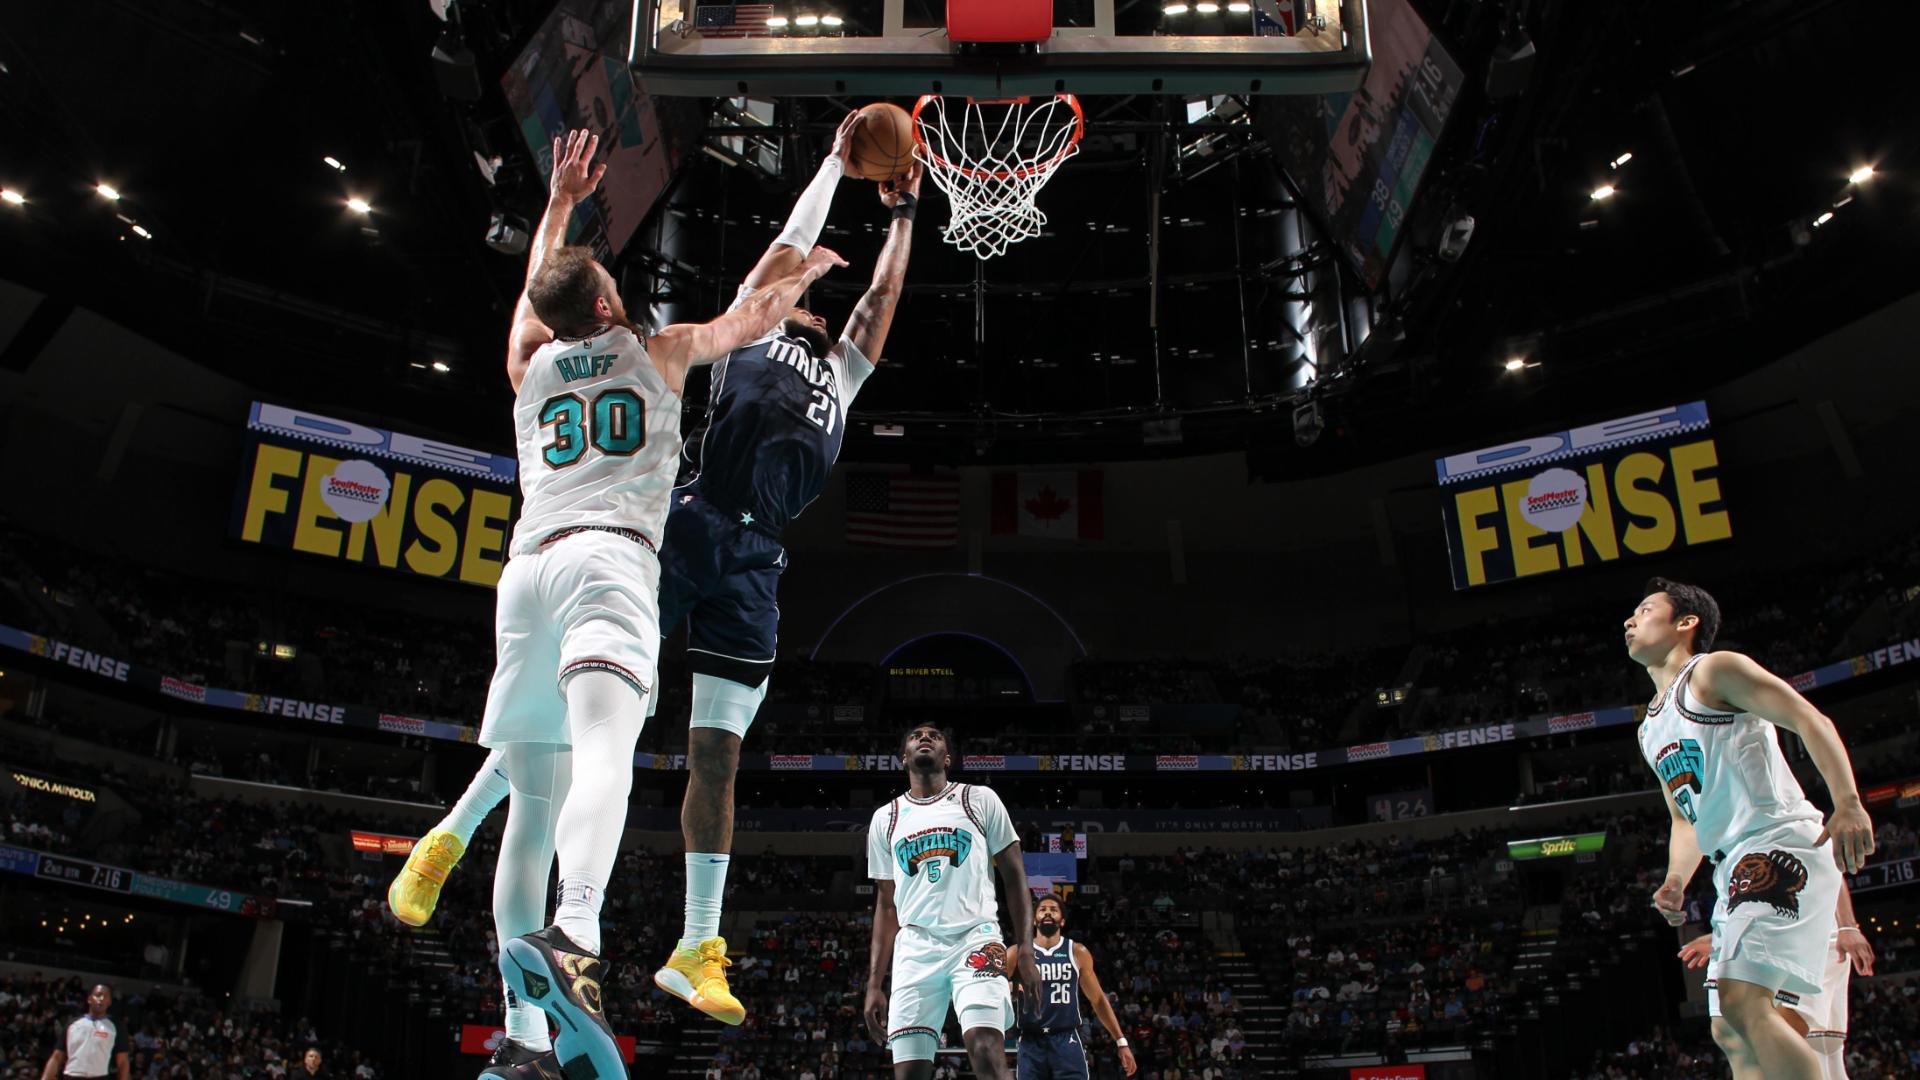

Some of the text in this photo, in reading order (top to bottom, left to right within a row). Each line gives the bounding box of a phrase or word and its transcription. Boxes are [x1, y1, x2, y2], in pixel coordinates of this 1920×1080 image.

[1413, 55, 1443, 107] 7:16
[1371, 178, 1390, 212] 38
[1385, 199, 1404, 230] 49
[556, 354, 618, 383] HUFF
[805, 389, 837, 436] 21
[257, 402, 494, 473] DE
[539, 388, 646, 470] 30
[1445, 405, 1681, 477] DE
[329, 477, 382, 495] SealMaster
[1528, 488, 1578, 505] SealMaster
[241, 443, 513, 588] FENSE
[1454, 438, 1733, 587] FENSE
[54, 641, 130, 682] FENSE
[890, 668, 904, 677] BIG
[906, 668, 929, 677] RIVER
[268, 696, 345, 724] FENSE
[1444, 724, 1515, 749] FENSE
[865, 754, 905, 771] FEN
[1058, 754, 1126, 771] FENSE
[1251, 752, 1318, 771] FENSE
[50, 782, 97, 803] MINOLTA
[1184, 820, 1215, 830] ONLY
[895, 828, 972, 877] GRIZZLIES
[1540, 840, 1577, 856] Sprite
[91, 865, 121, 889] 7:16
[926, 858, 942, 883] 5
[1880, 861, 1914, 887] 7:16
[206, 889, 231, 910] 49
[1035, 963, 1072, 981] AVS
[1050, 982, 1071, 1004] 26
